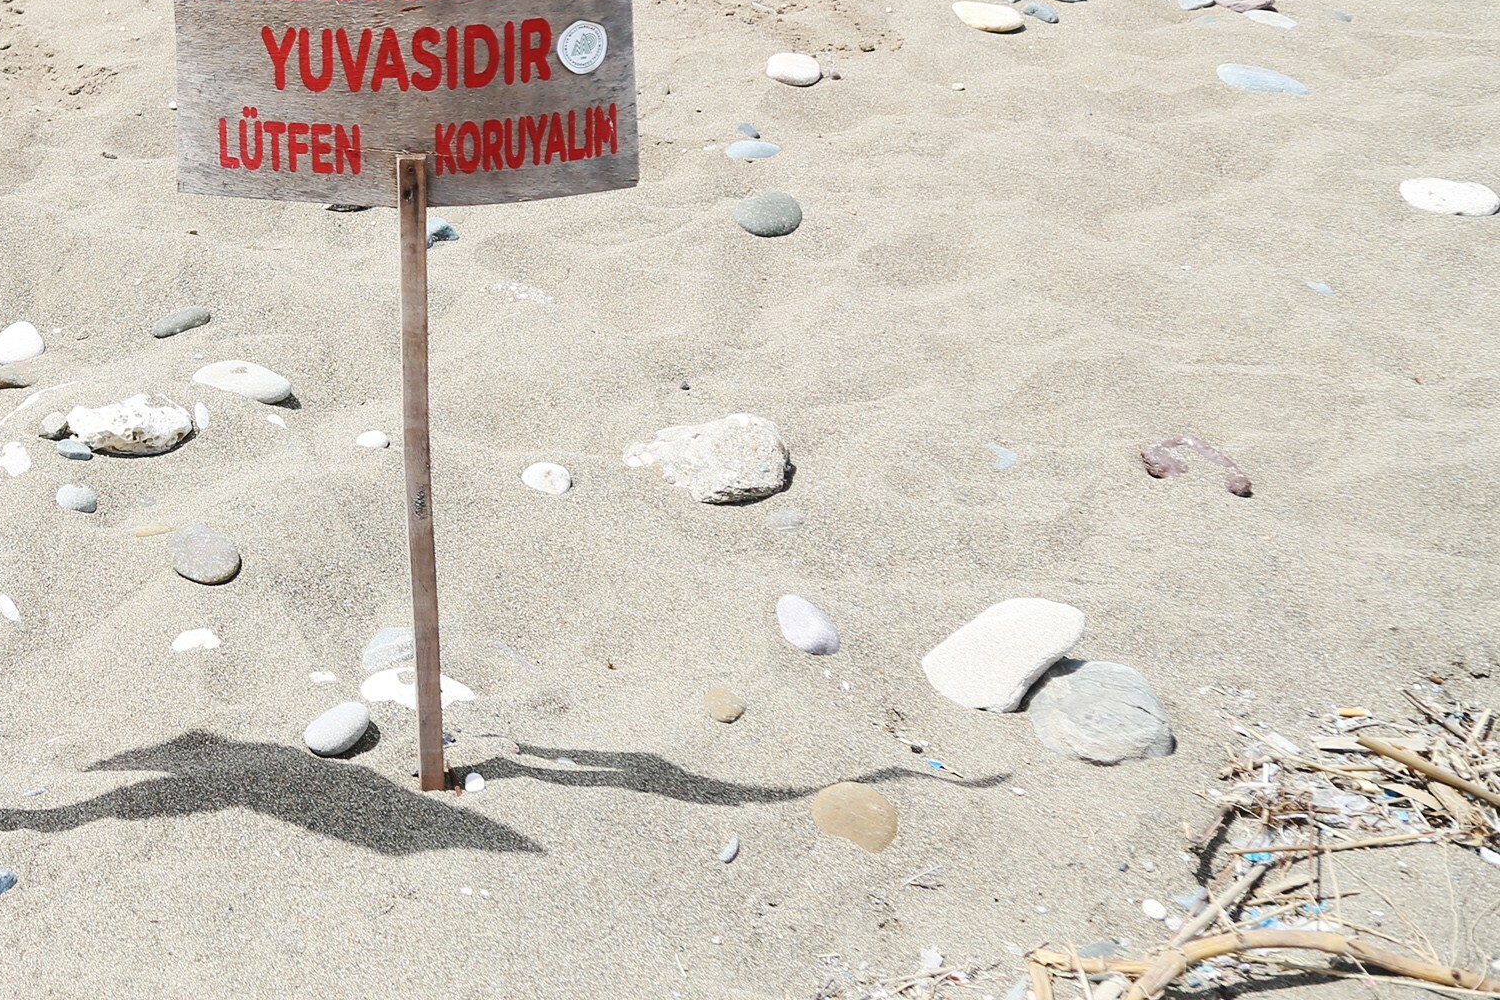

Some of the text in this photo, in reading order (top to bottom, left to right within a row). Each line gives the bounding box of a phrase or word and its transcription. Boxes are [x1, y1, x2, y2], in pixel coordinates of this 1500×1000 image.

[260, 18, 553, 93] YUVASIDIR
[218, 103, 618, 176] LÜTFEN KORUYALIM
